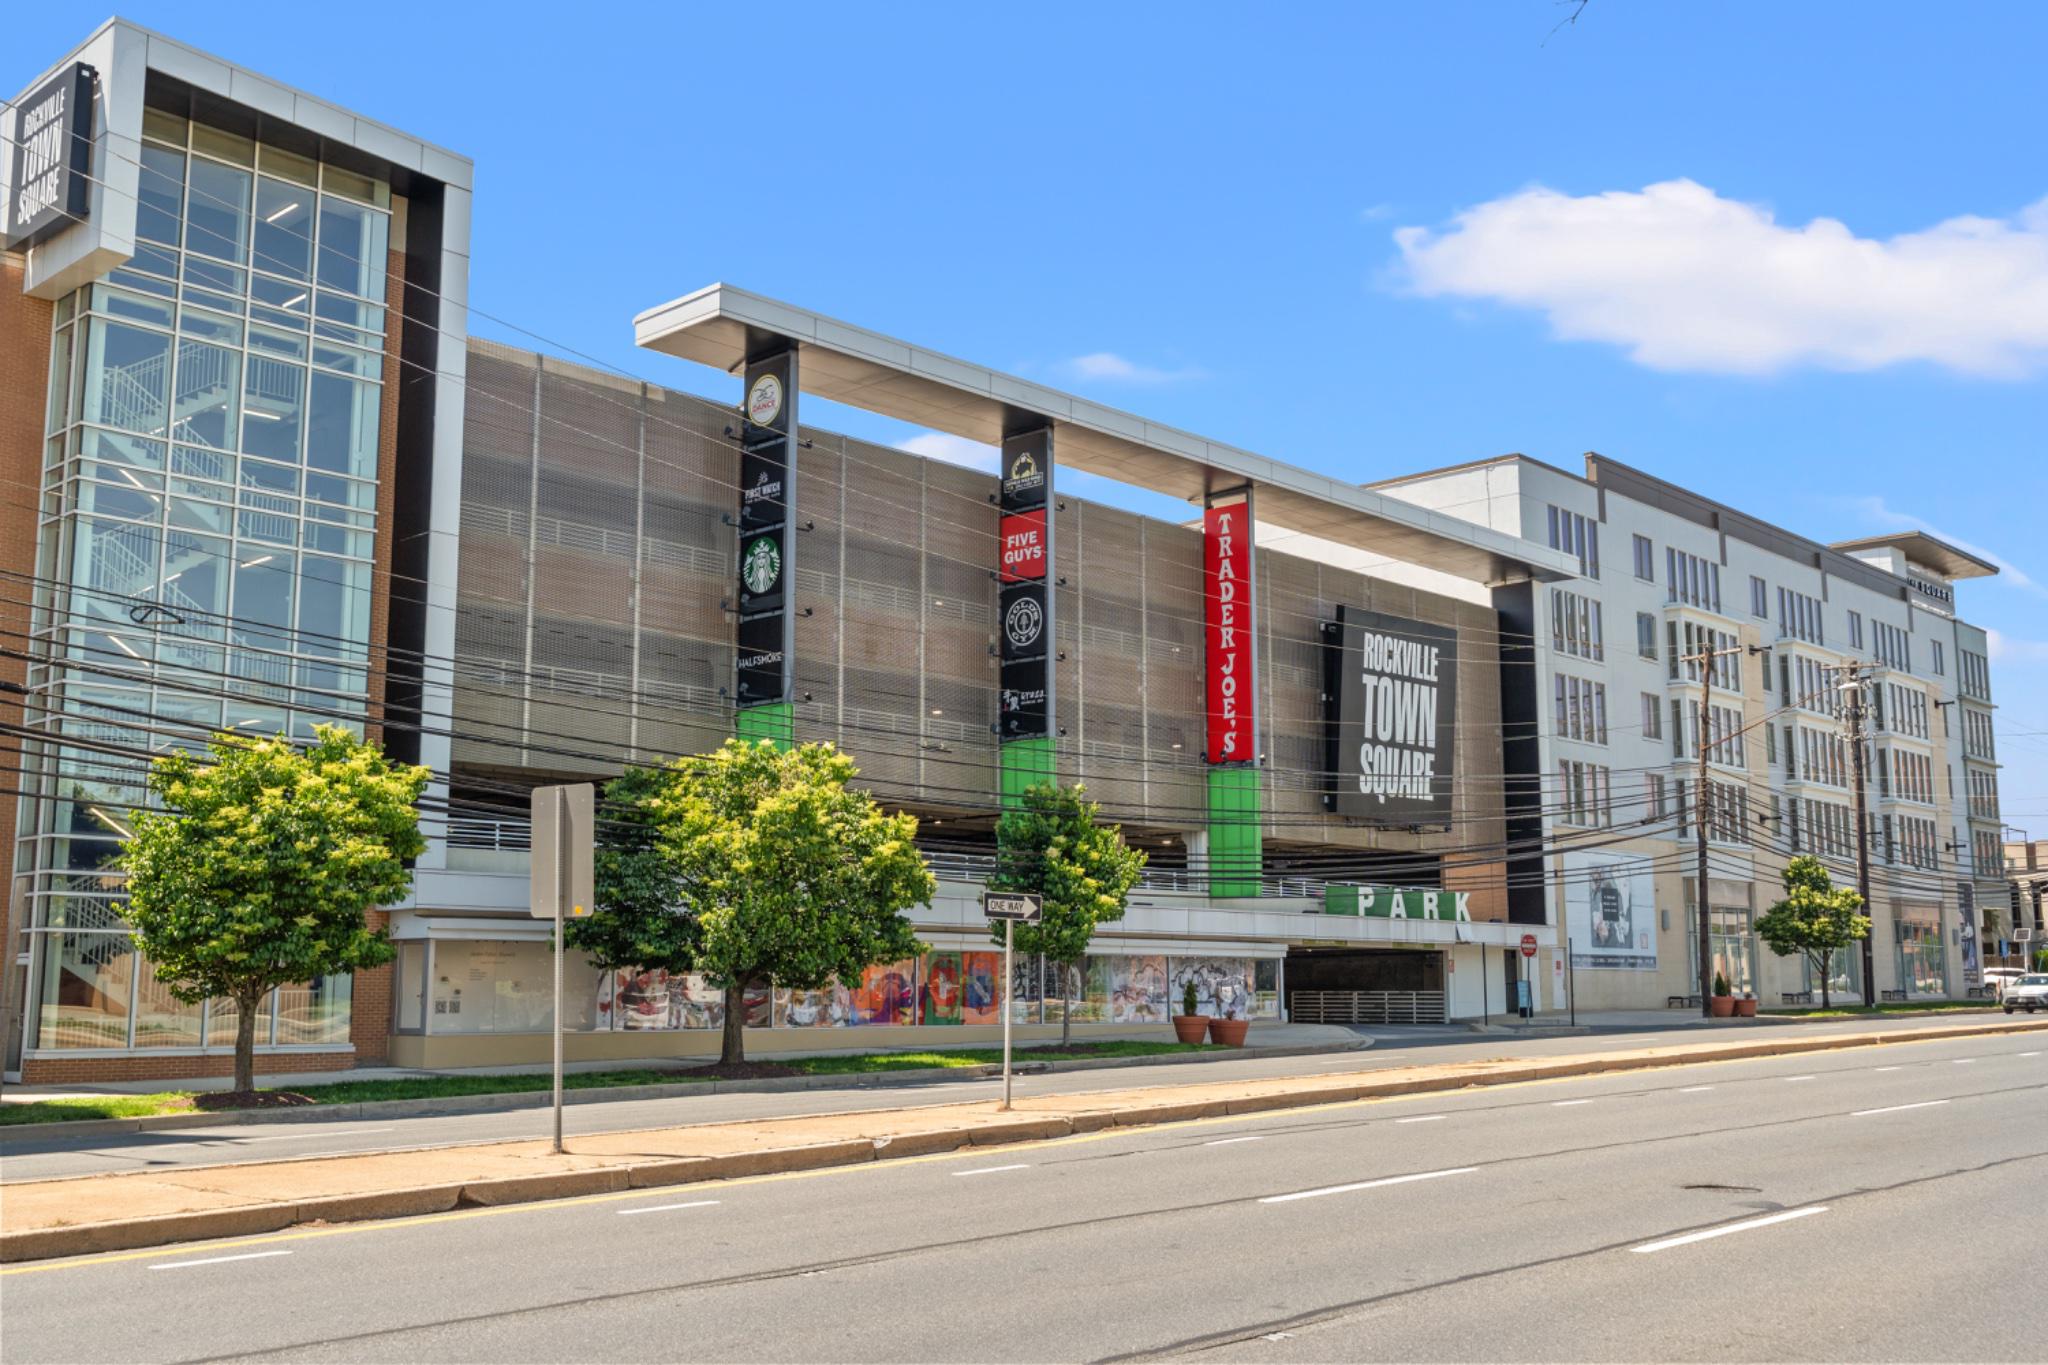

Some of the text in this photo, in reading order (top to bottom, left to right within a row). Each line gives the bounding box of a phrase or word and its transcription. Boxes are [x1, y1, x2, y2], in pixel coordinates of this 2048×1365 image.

[23, 86, 66, 139] ROCKVILLE
[22, 115, 63, 186] TOWN
[17, 166, 60, 225] SQUARE
[745, 481, 781, 500] FIRST WATCH
[1004, 546, 1042, 564] GUYS
[1007, 531, 1037, 548] FIVE
[1217, 512, 1237, 753] TRADER JOE'S
[1363, 631, 1439, 682] ROCKVILLE
[1362, 673, 1438, 749] TOWN
[1359, 743, 1436, 804] SQUARE
[990, 900, 1024, 911] ONE WAY
[1357, 886, 1472, 921] PARK
